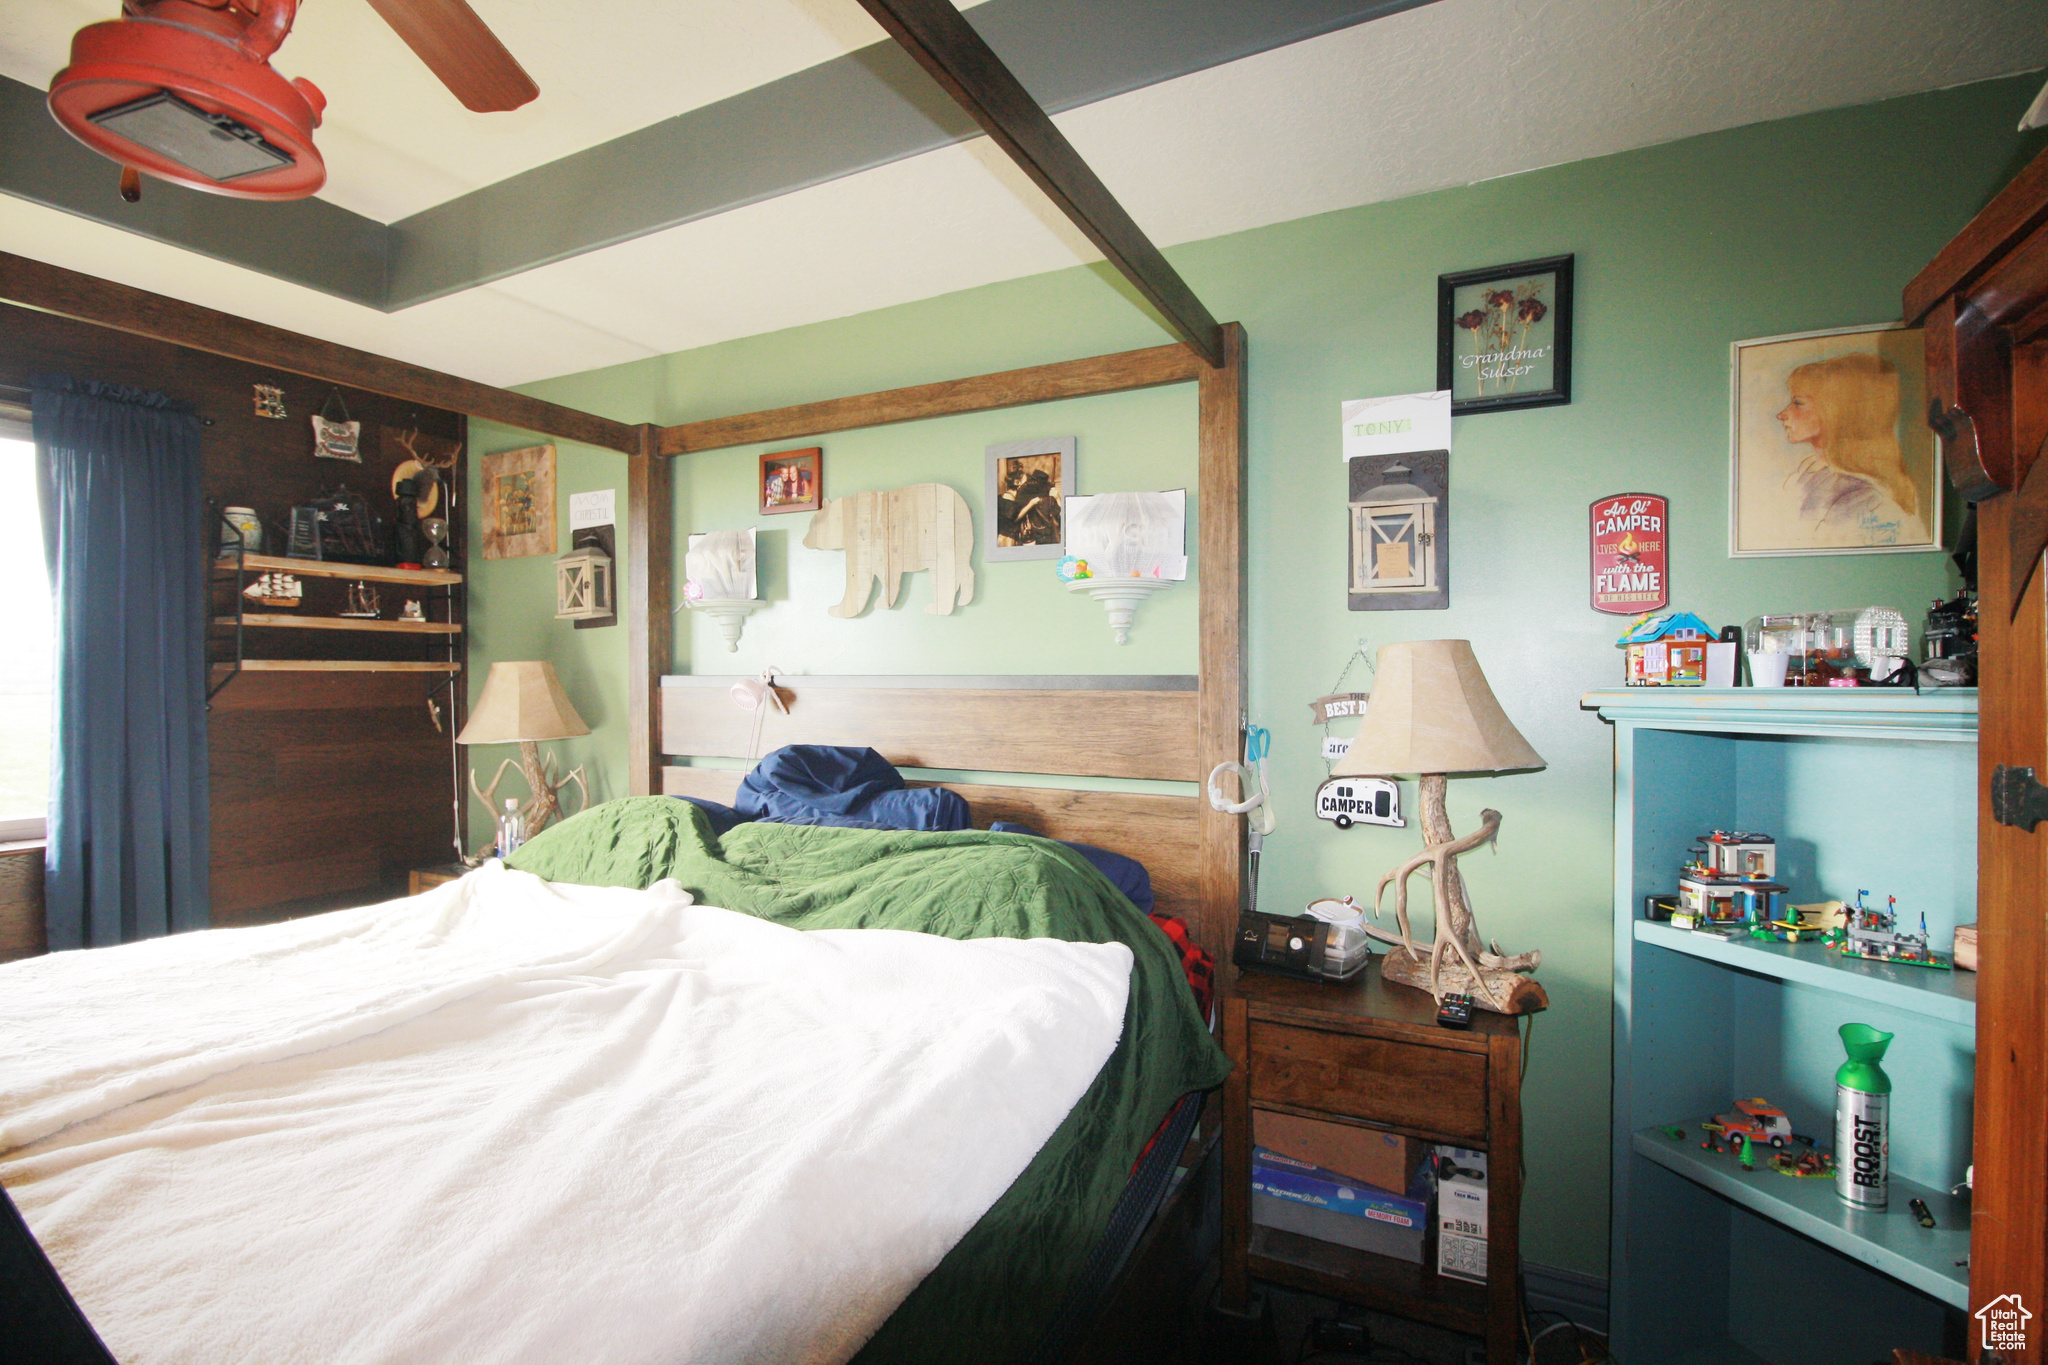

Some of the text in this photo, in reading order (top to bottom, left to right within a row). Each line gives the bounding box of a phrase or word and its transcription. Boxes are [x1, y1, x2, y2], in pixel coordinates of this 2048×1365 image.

[1477, 362, 1535, 380] Sulser
[574, 493, 609, 506] MOM
[1603, 501, 1628, 517] An
[1596, 515, 1661, 537] CAMPER
[1596, 541, 1661, 554] LIVES HERE
[1602, 562, 1655, 574] with the
[1597, 572, 1661, 593] FLAME
[1636, 593, 1655, 601] LIFE
[1349, 692, 1366, 700] THE
[1324, 700, 1356, 718] BEST
[1321, 796, 1373, 815] CAMPER
[1853, 1114, 1881, 1188] BOOST
[1367, 1209, 1410, 1226] MEMORY FOAM
